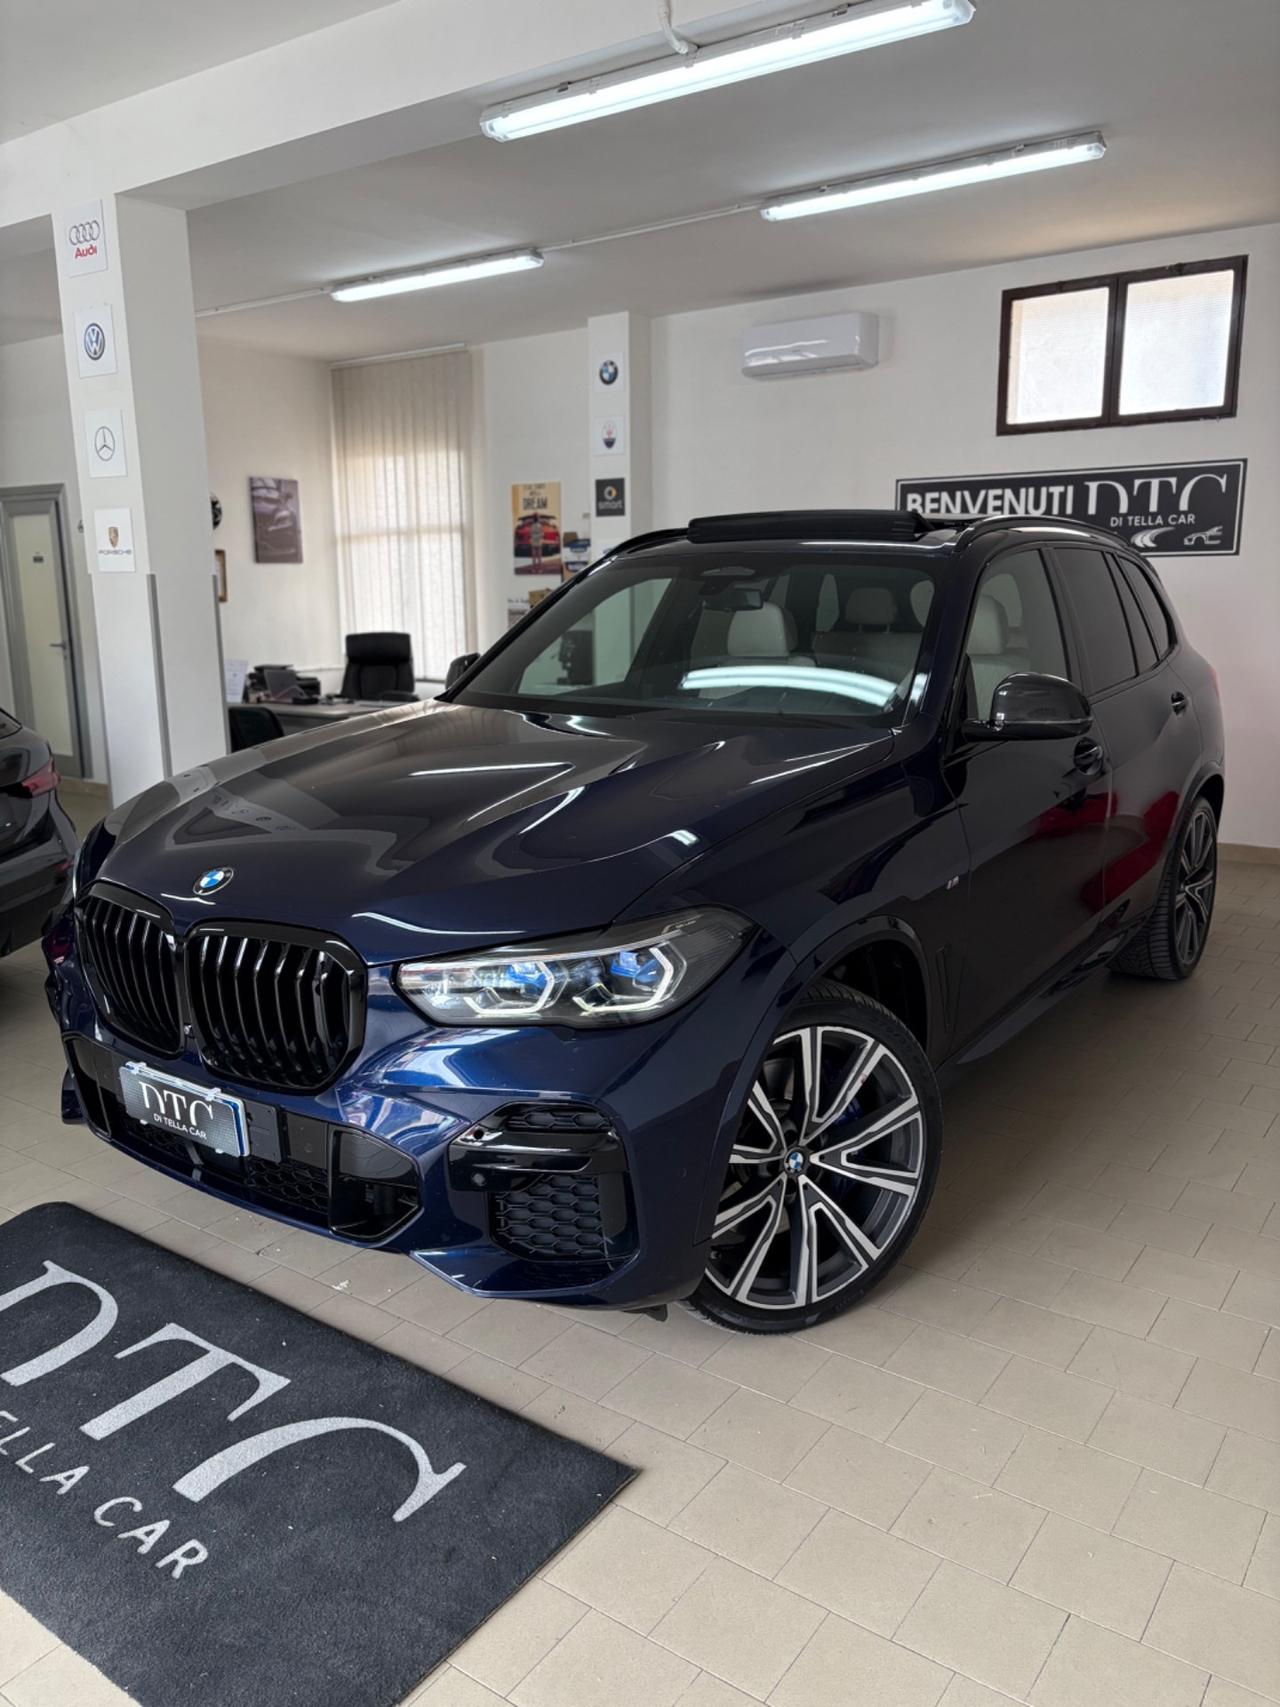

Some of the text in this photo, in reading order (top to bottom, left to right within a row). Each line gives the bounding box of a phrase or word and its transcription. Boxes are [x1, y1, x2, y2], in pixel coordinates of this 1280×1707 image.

[75, 244, 97, 259] Audi
[907, 473, 1227, 515] BENVENUTI DTC
[1110, 514, 1196, 527] DI TELLA CAR
[139, 1081, 214, 1126] DTC
[153, 1113, 208, 1140] DI TELLA CAR
[93, 1496, 209, 1579] CAR
